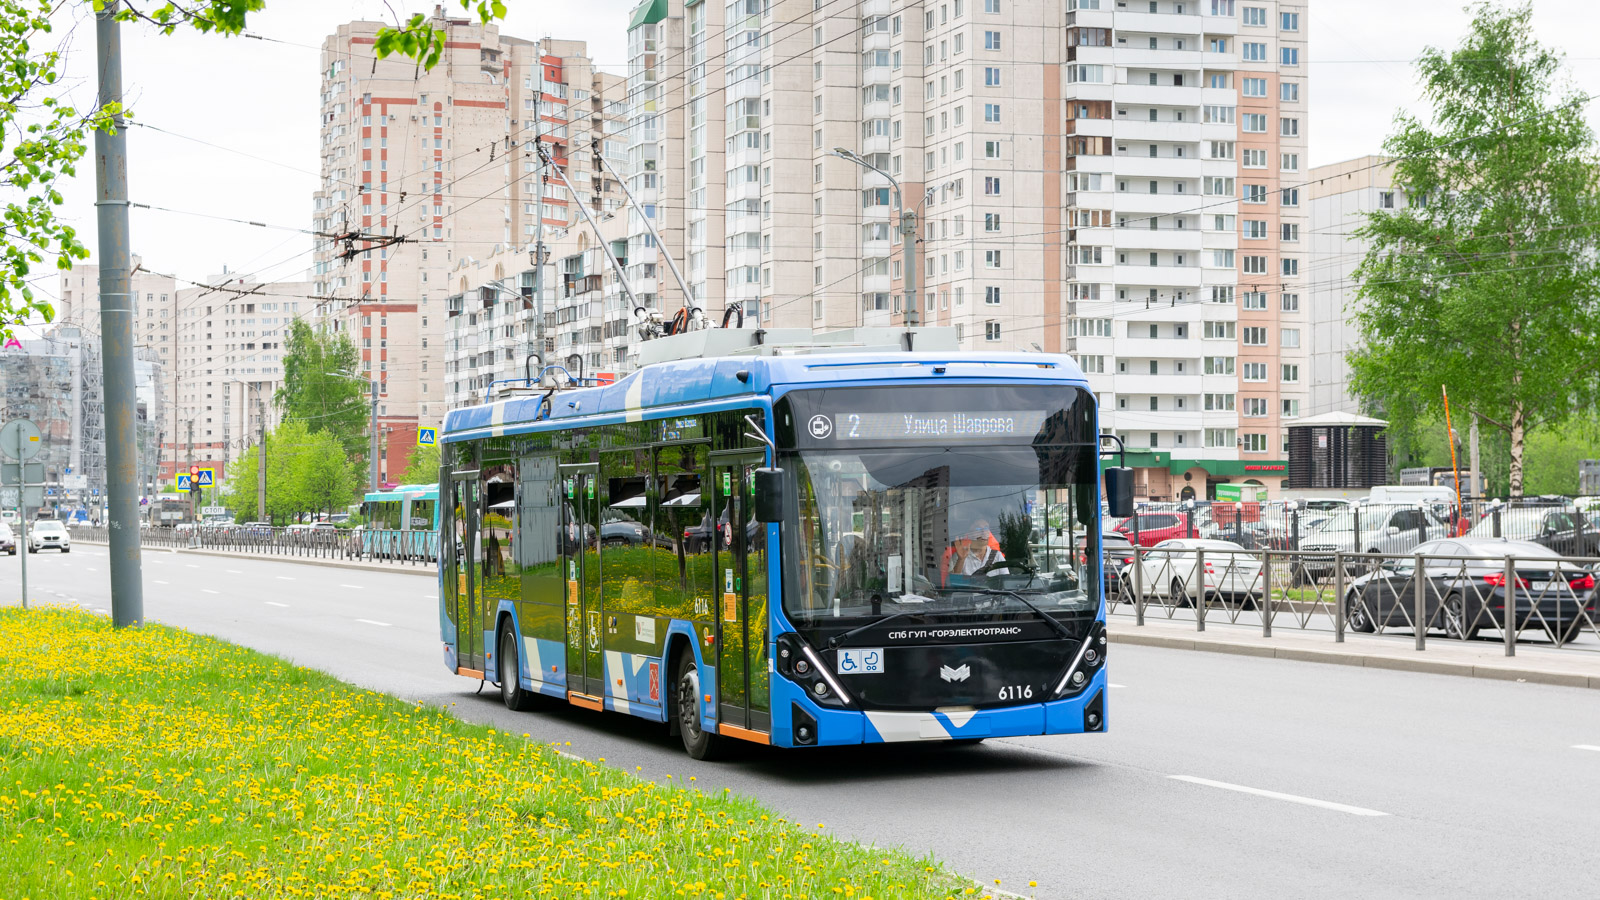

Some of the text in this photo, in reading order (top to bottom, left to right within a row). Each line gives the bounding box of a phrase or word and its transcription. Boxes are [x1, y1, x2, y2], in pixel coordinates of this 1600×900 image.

[848, 413, 1014, 438] 2 Улица Шаврова
[695, 598, 708, 614] 6116
[888, 626, 1022, 640] СПб ГУП «ГОРЭЛЕКТРОТРАНС»
[998, 684, 1033, 700] 6116
